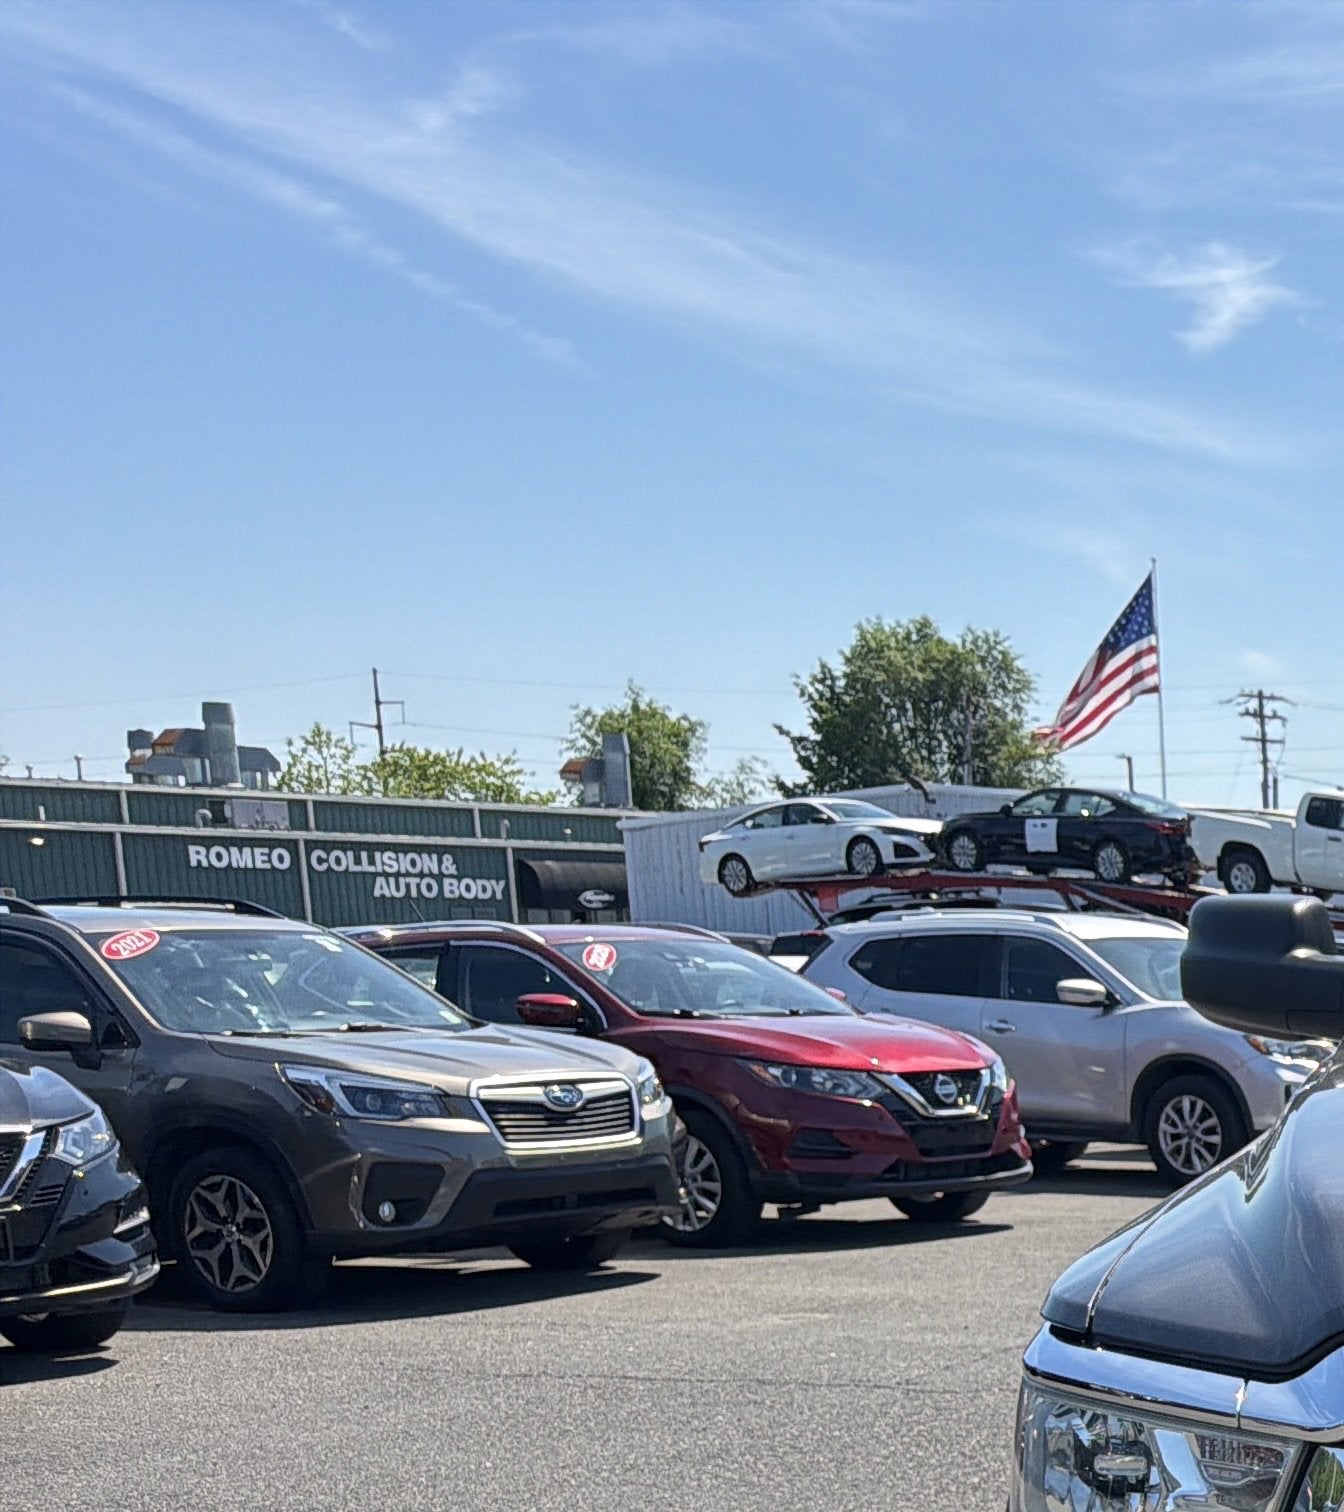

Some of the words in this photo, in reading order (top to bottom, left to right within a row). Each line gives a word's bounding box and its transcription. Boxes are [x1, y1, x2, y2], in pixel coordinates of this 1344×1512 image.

[187, 844, 291, 870] ROMEO
[310, 849, 439, 875] COLLISION
[441, 853, 458, 875] &
[373, 876, 438, 898] AUTO
[443, 878, 506, 900] BODY
[110, 930, 153, 957] 2021
